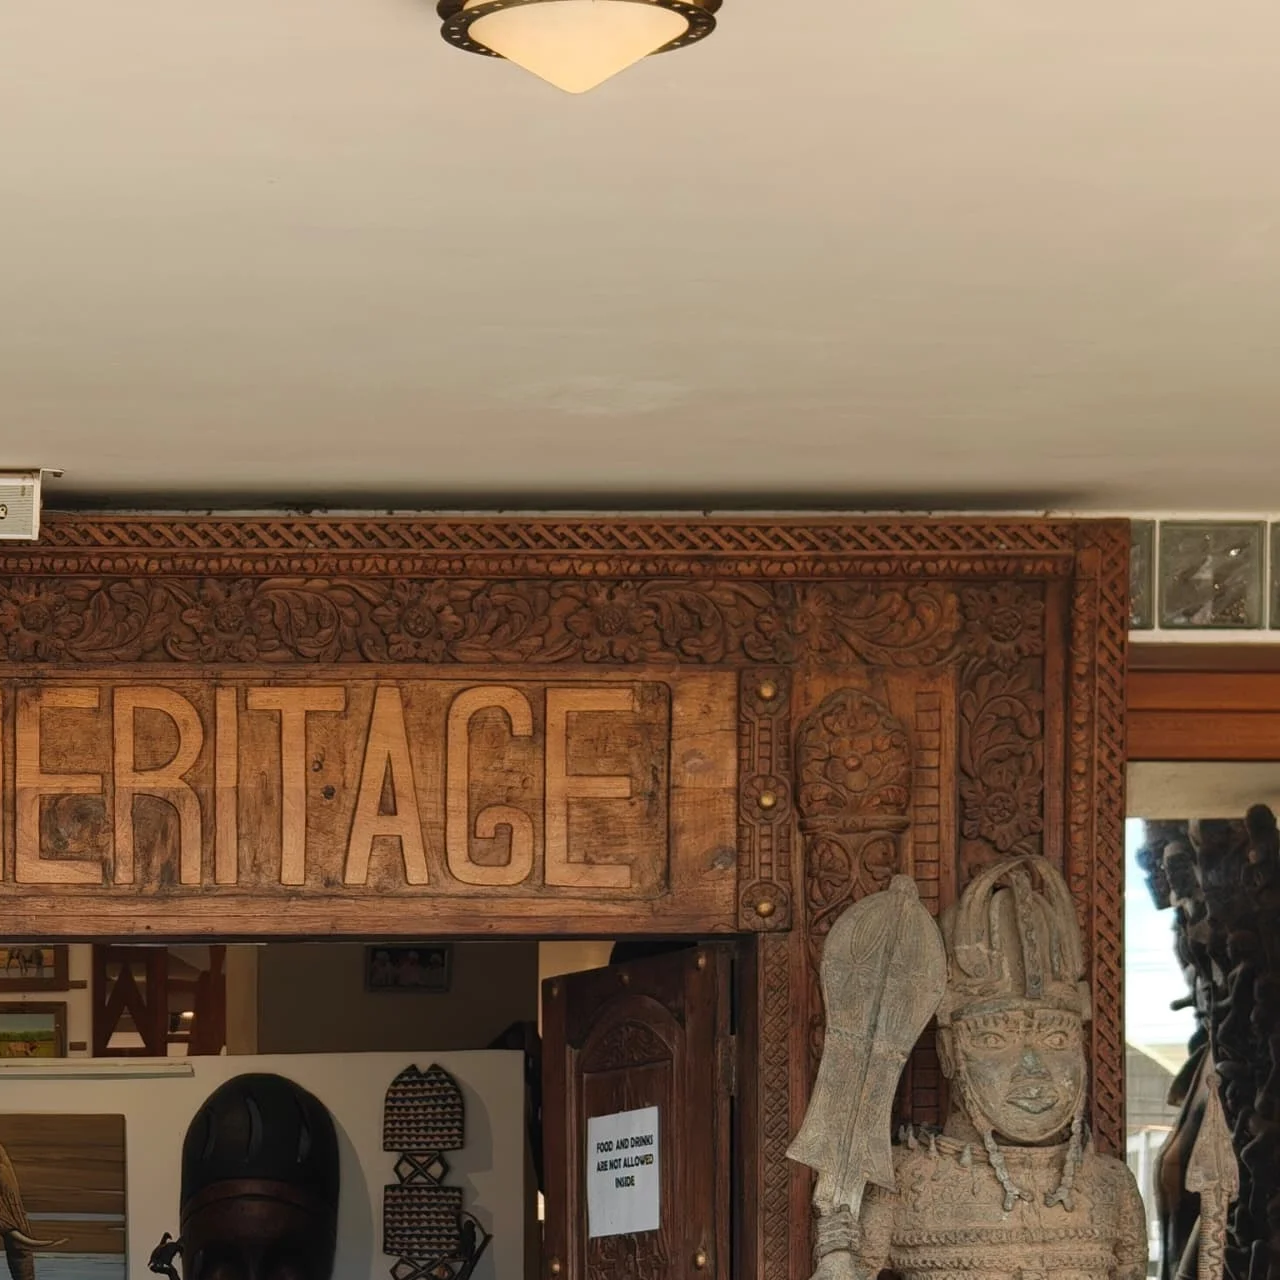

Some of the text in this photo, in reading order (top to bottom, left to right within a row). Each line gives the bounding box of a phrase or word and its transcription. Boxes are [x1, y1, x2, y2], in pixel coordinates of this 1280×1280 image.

[597, 1135, 653, 1154] FOOD AND DRINKS
[597, 1154, 653, 1172] ARE NOT ALLOWED
[615, 1176, 635, 1188] INSIDE
